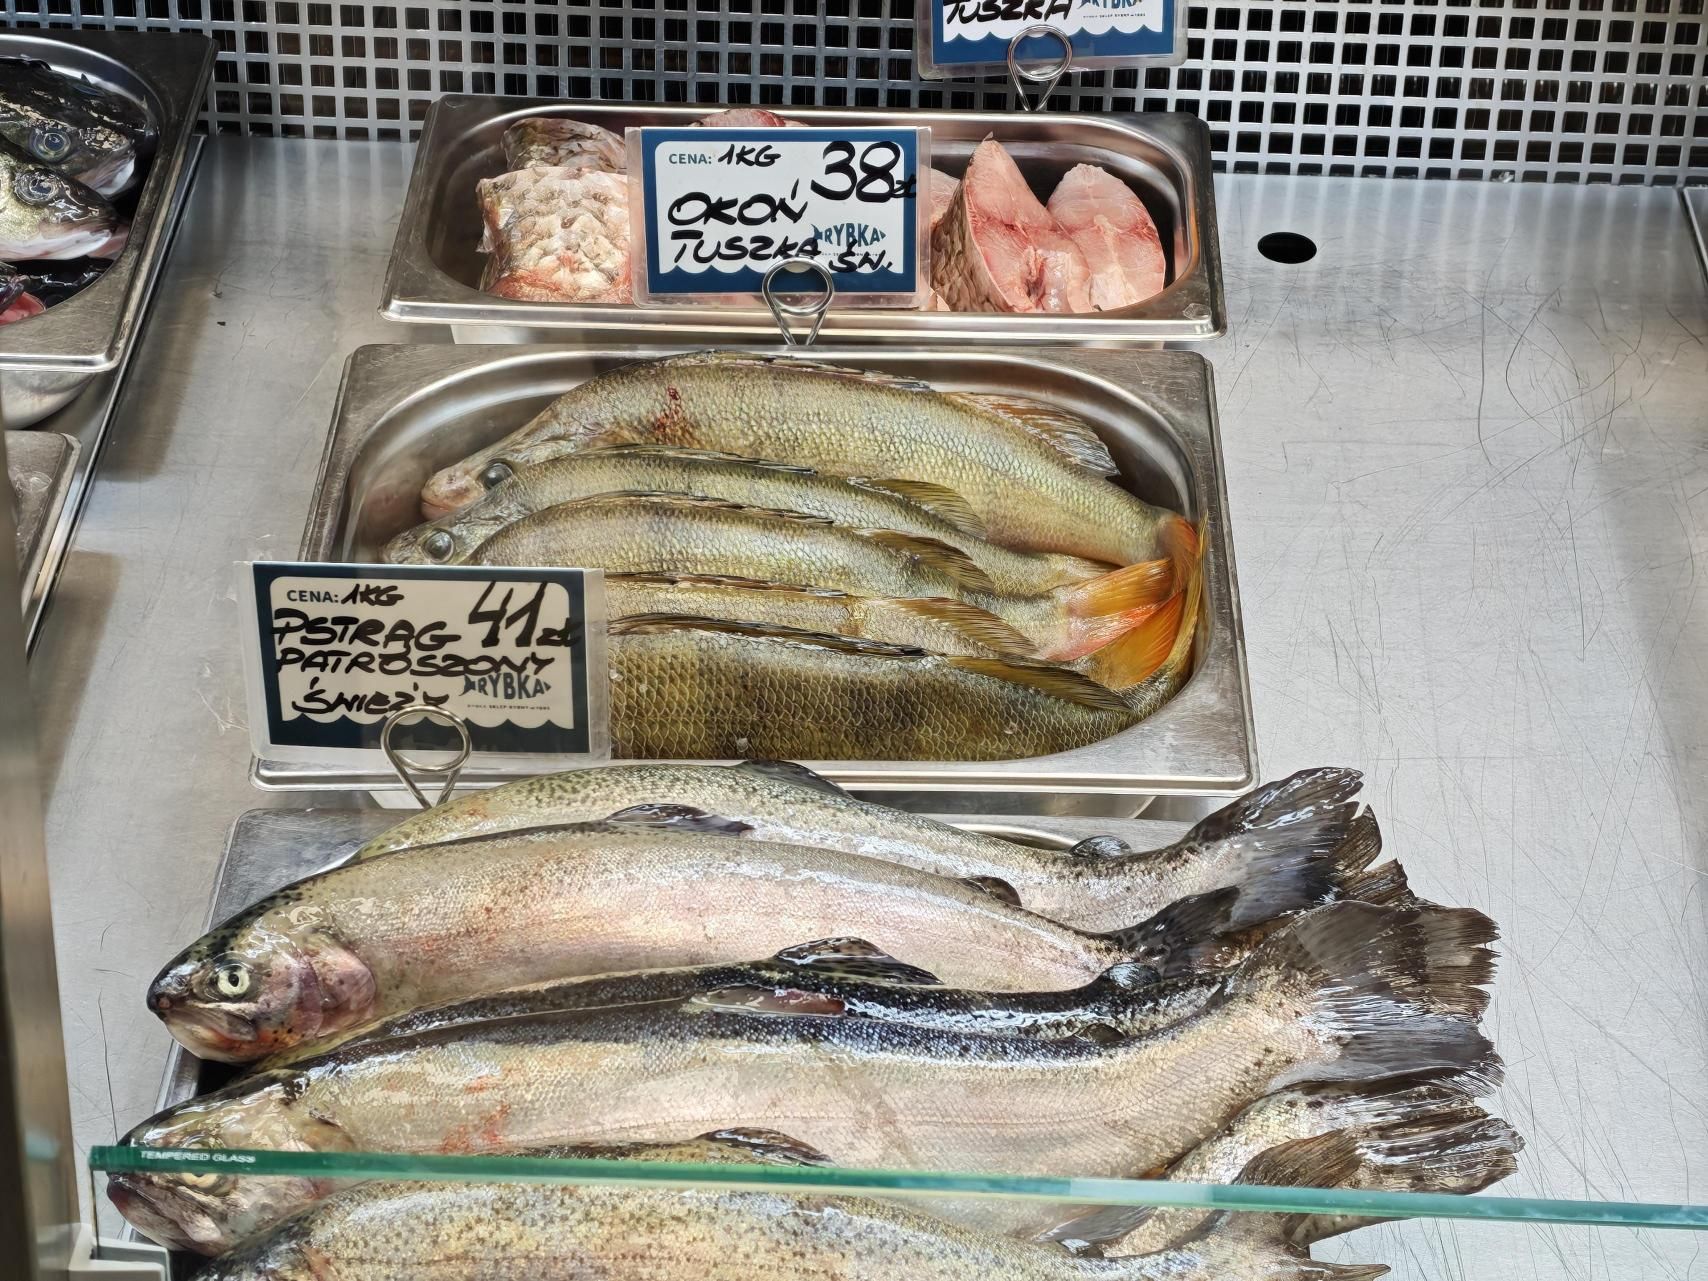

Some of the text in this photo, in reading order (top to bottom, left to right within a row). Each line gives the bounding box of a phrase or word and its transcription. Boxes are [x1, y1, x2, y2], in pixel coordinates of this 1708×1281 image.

[668, 143, 781, 167] CENA: 1KG
[824, 222, 881, 248] RYBKA
[286, 583, 405, 606] CENA: 1KG
[477, 671, 545, 700] RYBKA
[141, 1150, 256, 1164] TEMPERED GLASS
